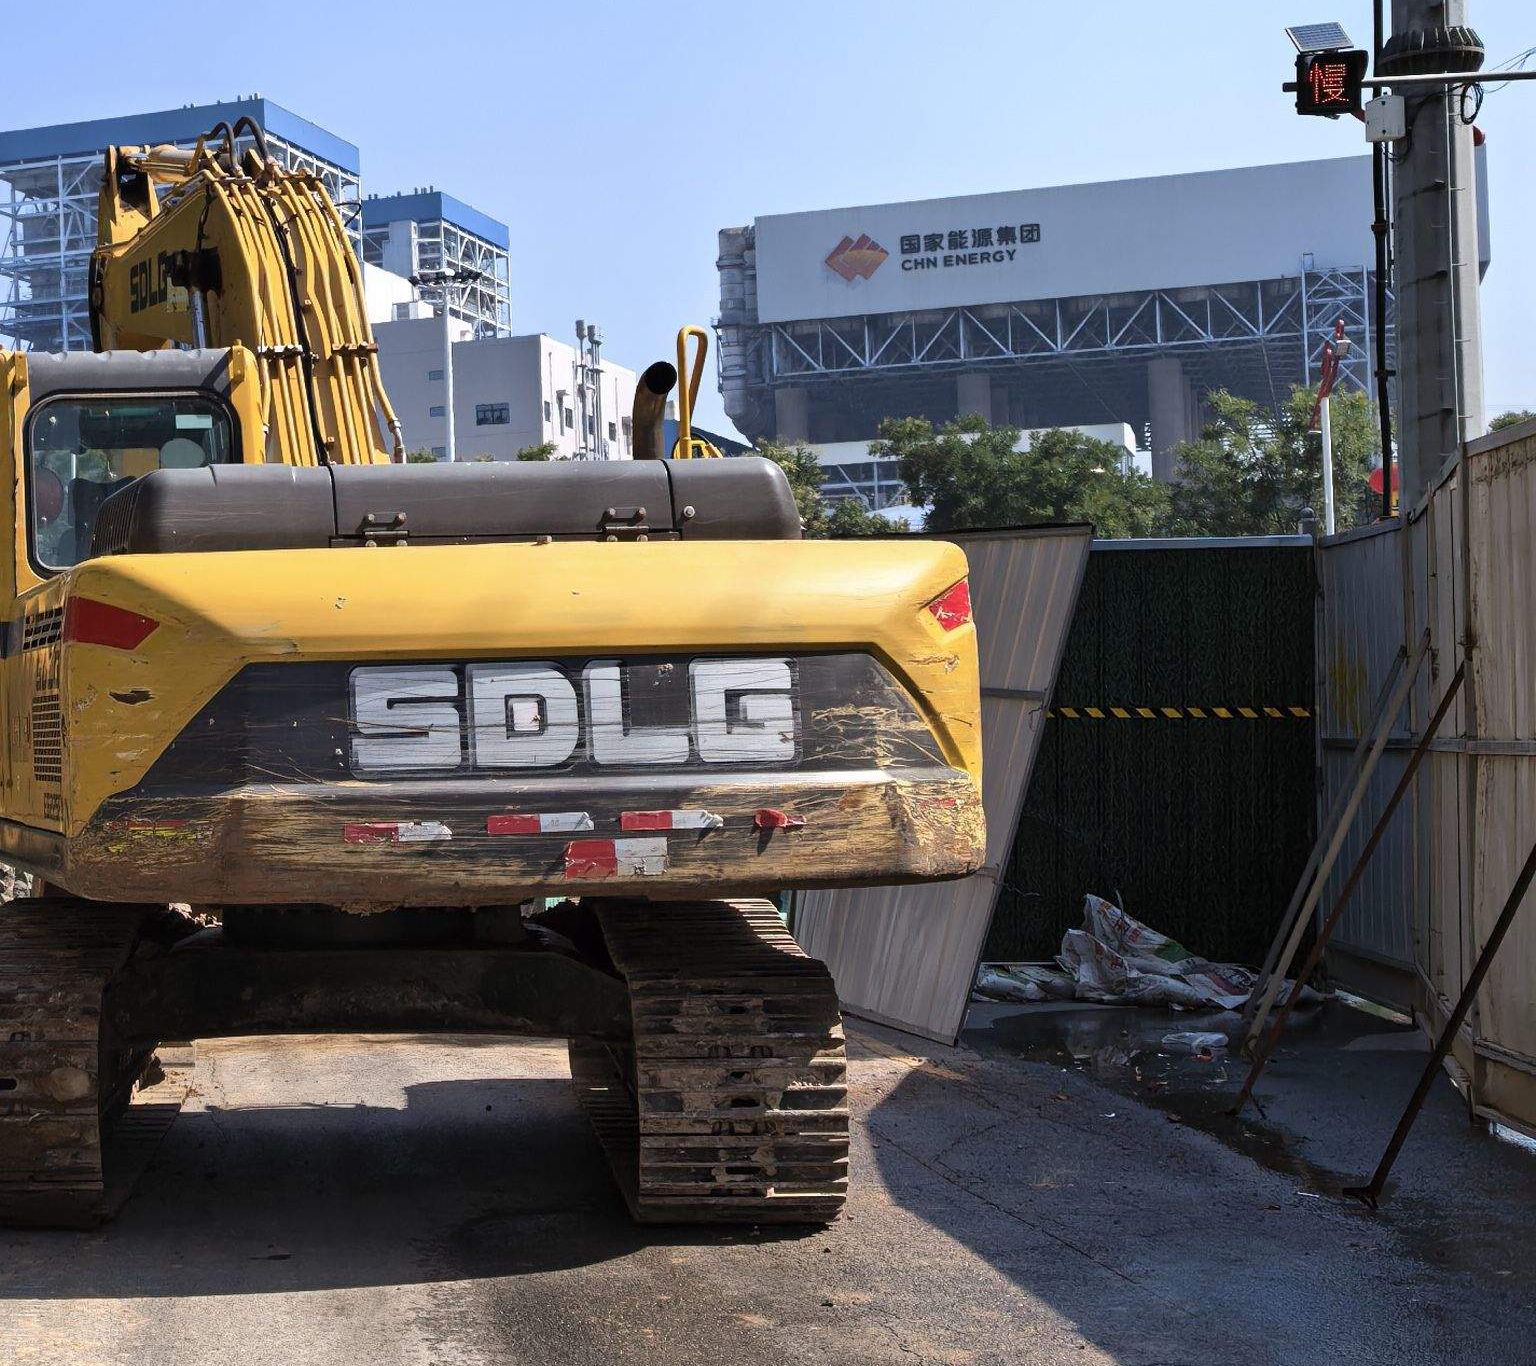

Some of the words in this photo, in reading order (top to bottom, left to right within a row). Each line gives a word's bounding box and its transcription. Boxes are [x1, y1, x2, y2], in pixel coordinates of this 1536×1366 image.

[1309, 63, 1349, 104] 慢
[900, 223, 1041, 254] 国家能源集团
[901, 256, 938, 271] CHN
[943, 249, 1017, 268] ENERGY
[348, 657, 800, 776] SDLG
